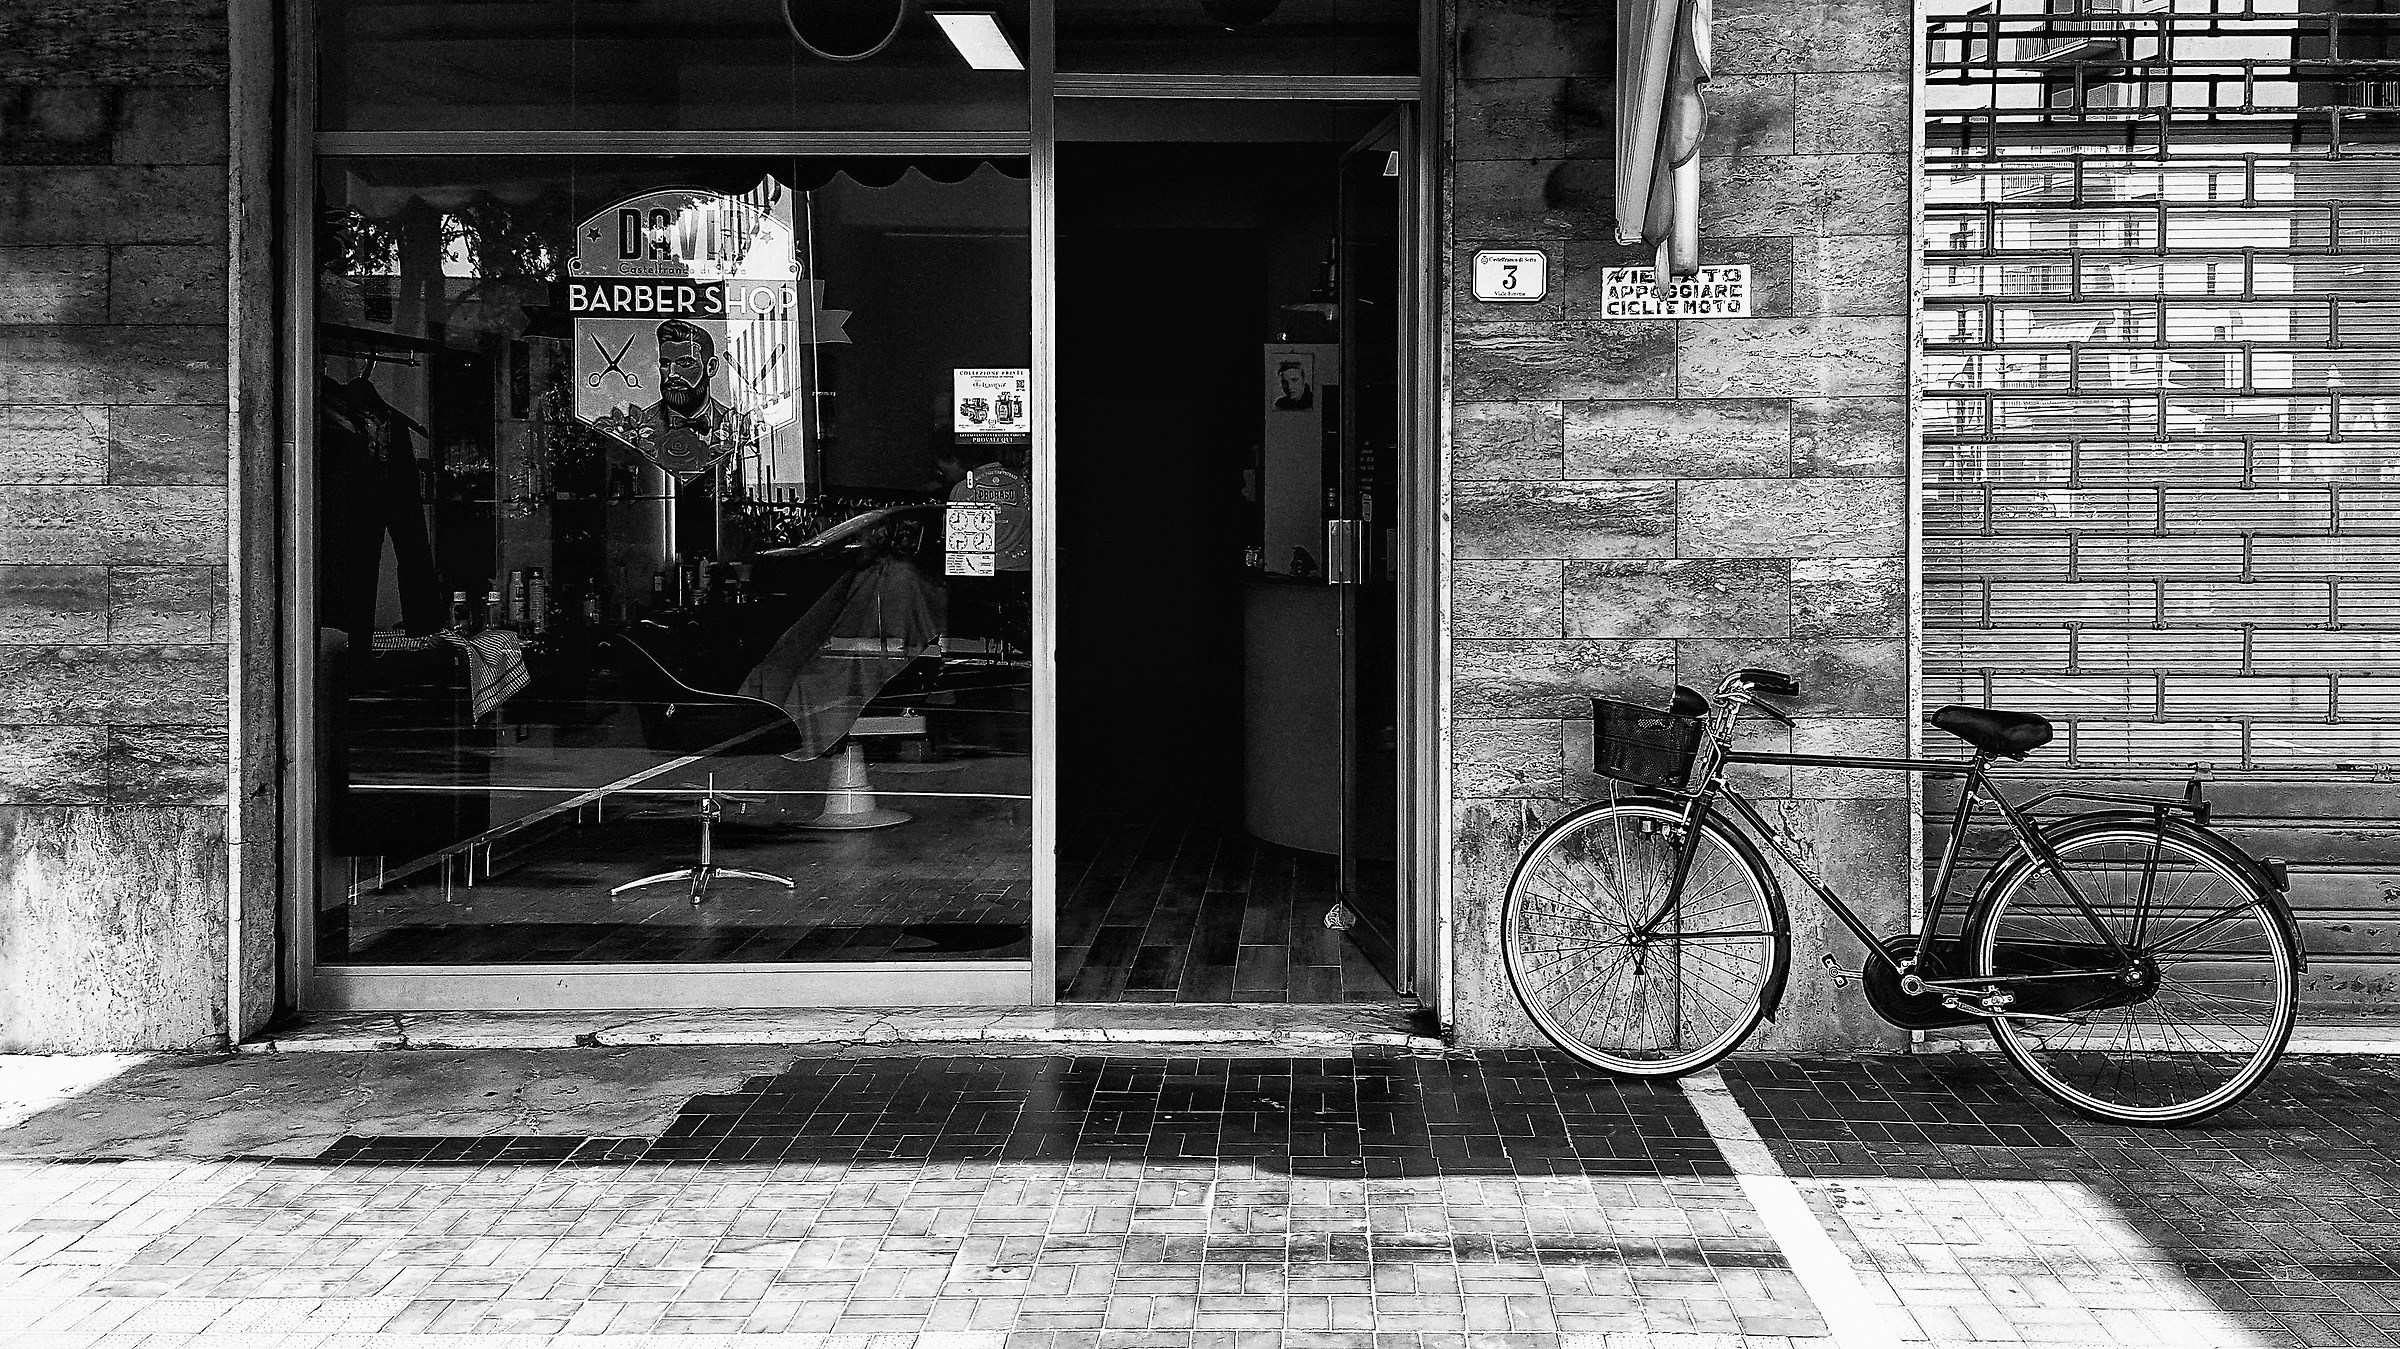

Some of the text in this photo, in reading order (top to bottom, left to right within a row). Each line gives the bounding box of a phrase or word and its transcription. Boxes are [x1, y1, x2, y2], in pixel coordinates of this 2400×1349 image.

[619, 262, 695, 274] Castelfranco
[1607, 267, 1742, 285] VIEATO
[1502, 265, 1517, 290] 3
[569, 284, 796, 314] BARBER SHOP
[1608, 284, 1742, 300] APPOGGIARE
[1607, 300, 1661, 315] CICLI
[1684, 299, 1741, 315] MOTO
